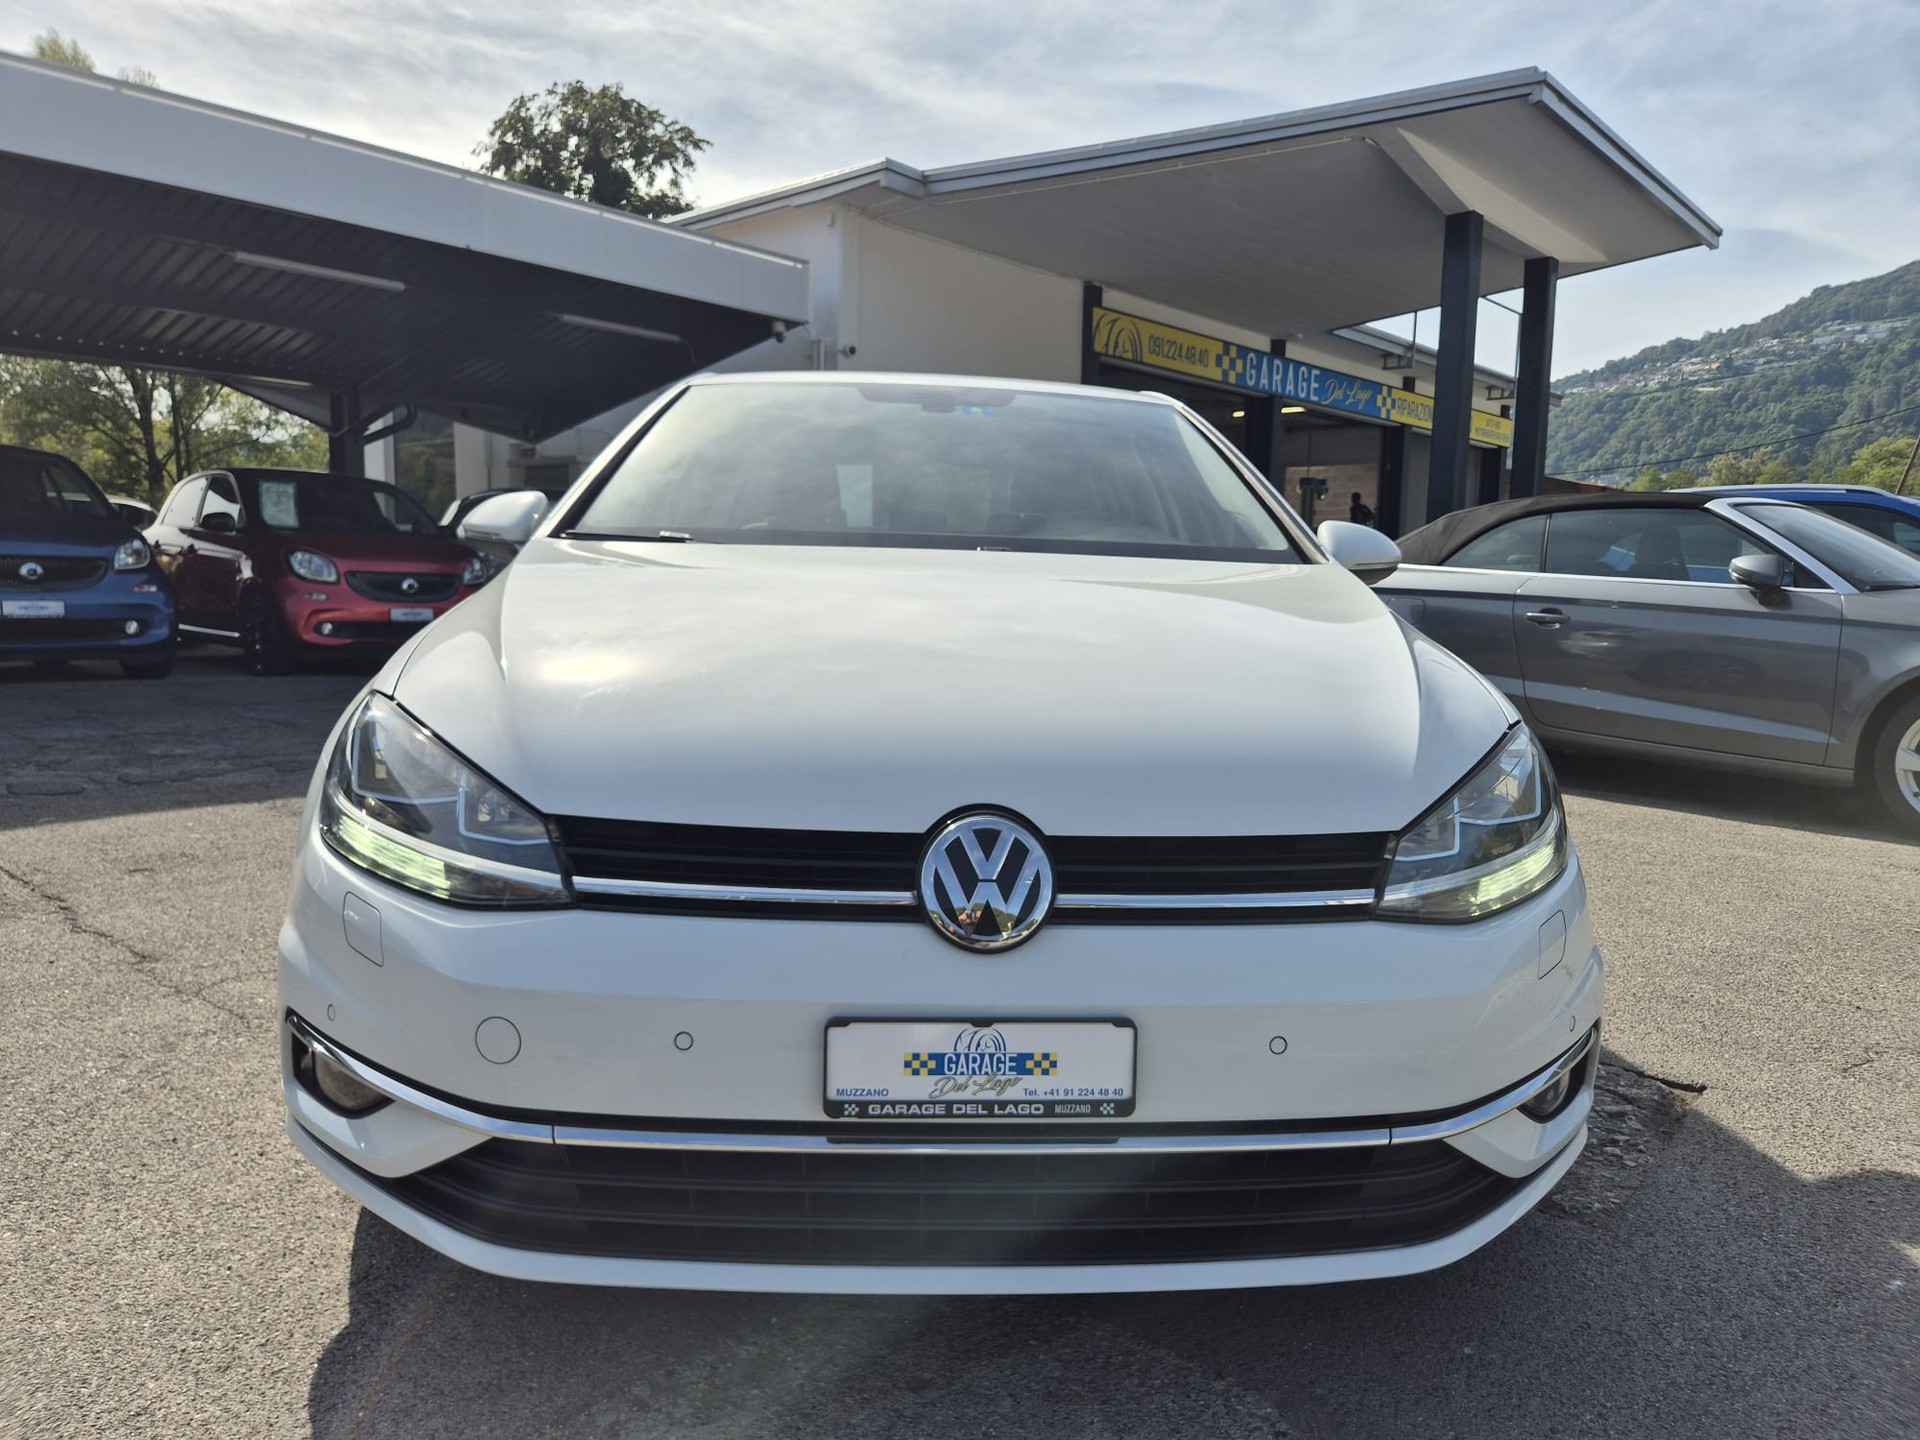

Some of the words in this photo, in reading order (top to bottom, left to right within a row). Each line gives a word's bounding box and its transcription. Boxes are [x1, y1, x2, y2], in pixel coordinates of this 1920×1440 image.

[1149, 335, 1209, 368] 091.224.48.40
[1246, 352, 1320, 401] GARAGE
[1321, 378, 1346, 405] Del
[1345, 379, 1373, 410] Lago
[943, 1053, 1018, 1075] GARAGE
[836, 1088, 889, 1097] MUZZANO
[928, 1075, 972, 1099] Del
[971, 1071, 1023, 1097] Lago
[1023, 1088, 1040, 1097] Tel.
[1043, 1088, 1060, 1097] +41
[1063, 1088, 1075, 1097] 91
[1077, 1088, 1095, 1097] 224
[1097, 1088, 1109, 1097] 48
[1111, 1088, 1124, 1097] 40
[867, 1103, 946, 1115] GARAGE
[952, 1103, 988, 1115] DEL
[993, 1103, 1044, 1115] LAGO
[1054, 1104, 1091, 1114] MUZZANO
